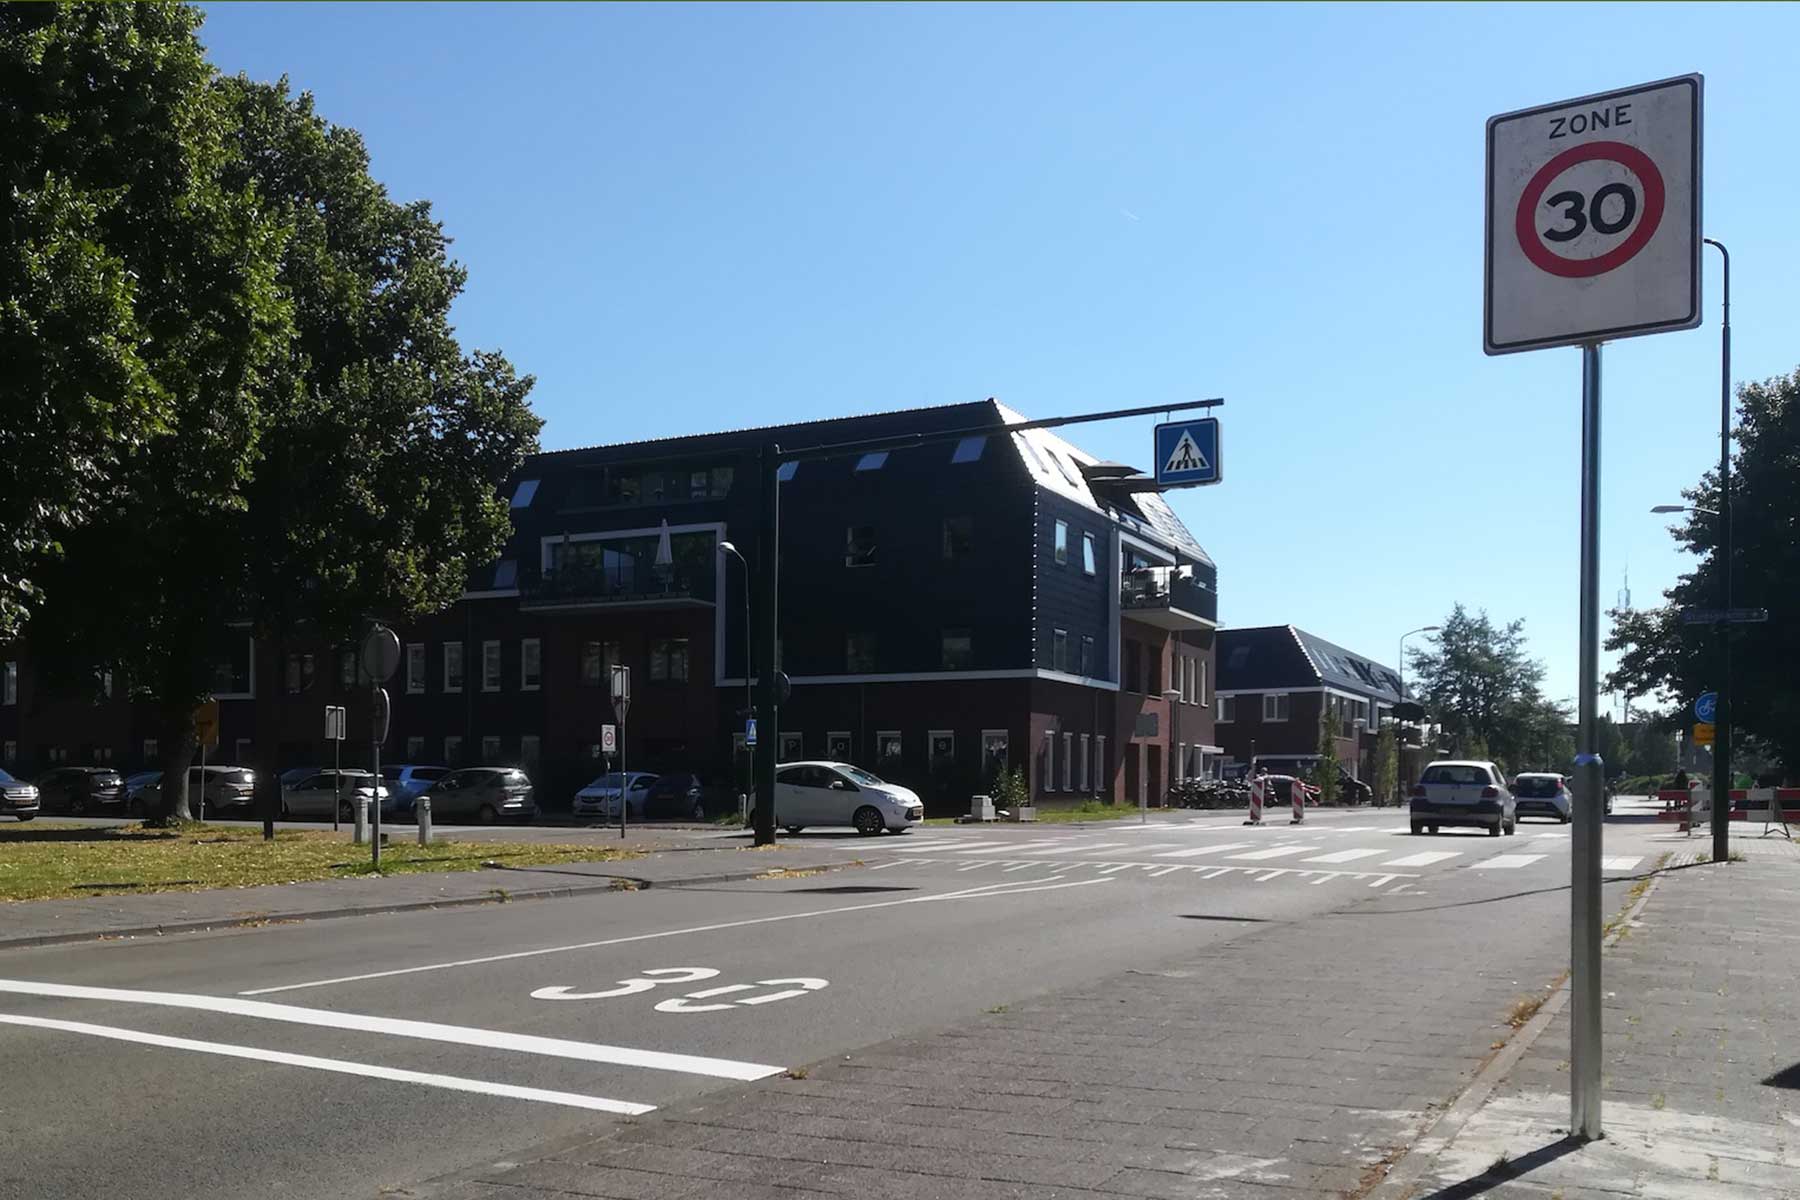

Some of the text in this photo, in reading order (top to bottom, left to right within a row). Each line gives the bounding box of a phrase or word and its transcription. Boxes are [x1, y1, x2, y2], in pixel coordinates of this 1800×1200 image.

[1549, 104, 1632, 140] ZONE
[1543, 182, 1637, 242] 30
[530, 967, 830, 1013] 30
